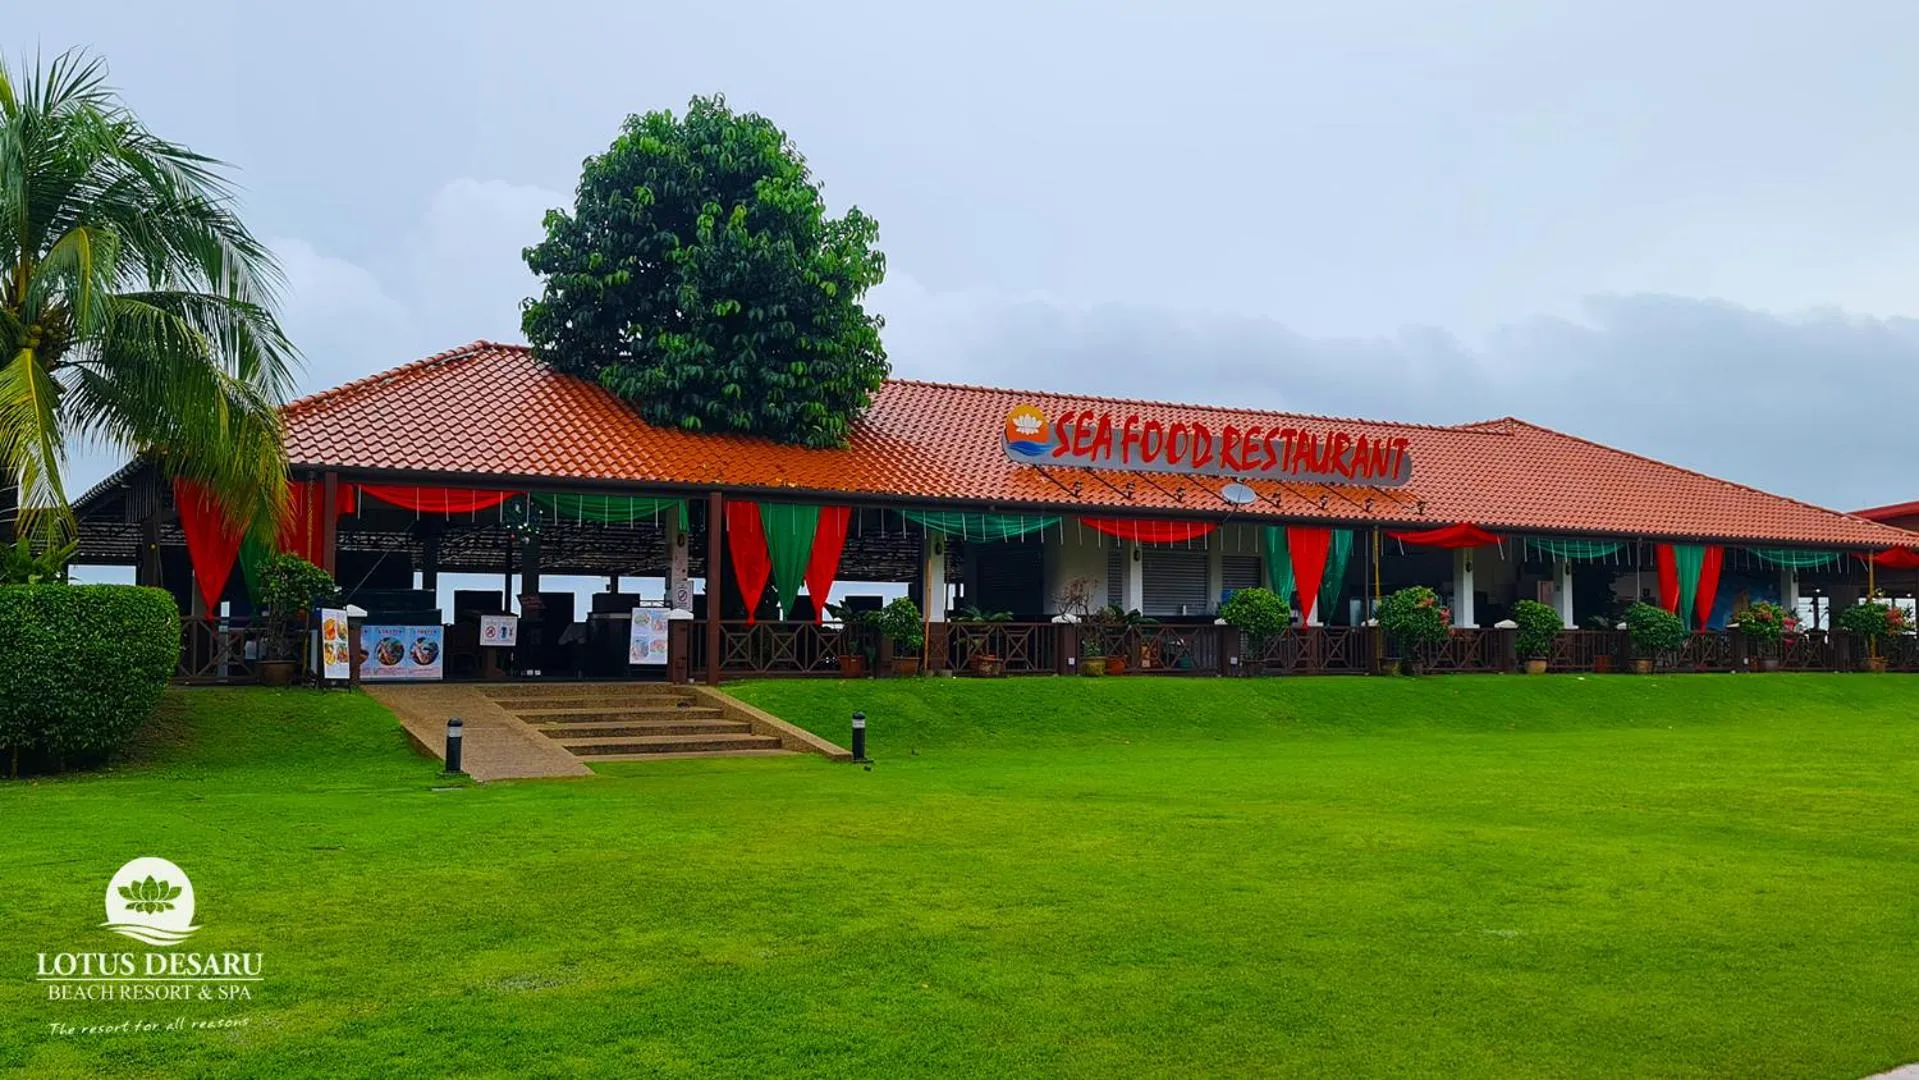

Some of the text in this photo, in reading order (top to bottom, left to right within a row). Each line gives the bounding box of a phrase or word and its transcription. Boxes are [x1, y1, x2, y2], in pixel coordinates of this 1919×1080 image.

[1052, 410, 1409, 480] SEA FOOD RESTAURANT
